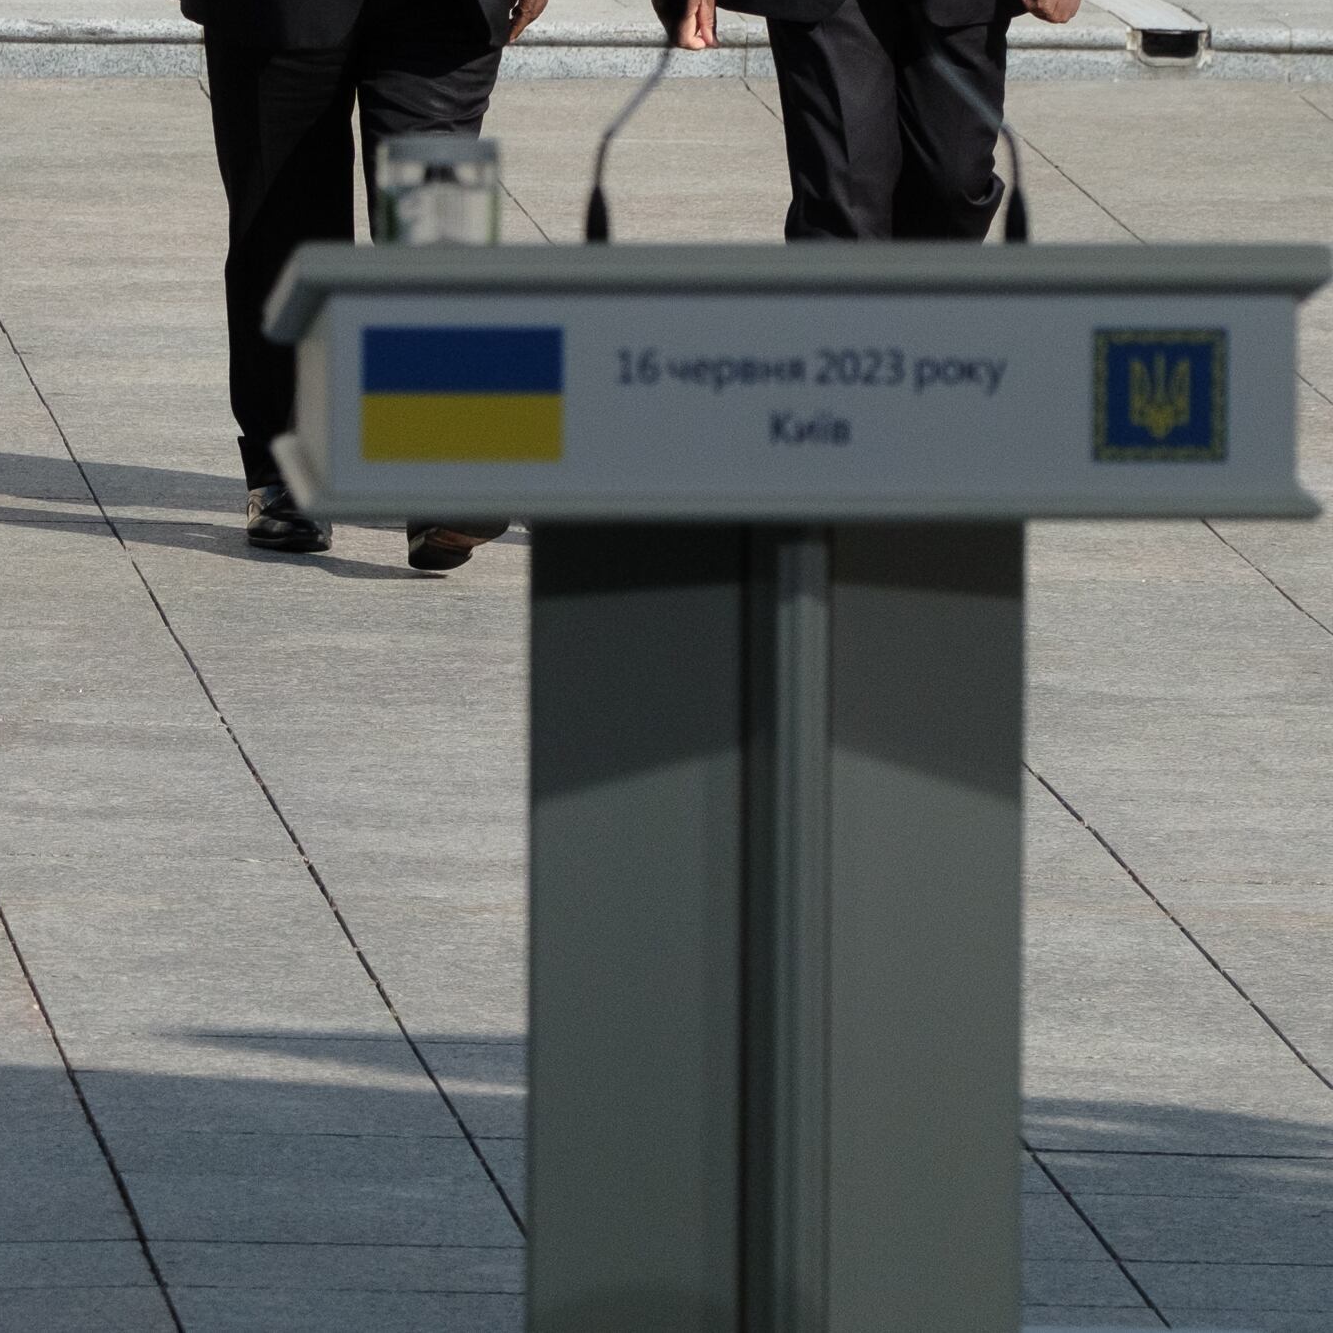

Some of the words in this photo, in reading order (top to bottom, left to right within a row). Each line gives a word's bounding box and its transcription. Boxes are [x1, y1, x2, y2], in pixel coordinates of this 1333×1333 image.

[617, 348, 660, 385] 16
[667, 356, 806, 393] червня
[815, 348, 905, 386] 2023
[913, 358, 1007, 396] року
[769, 411, 852, 446] Київ
